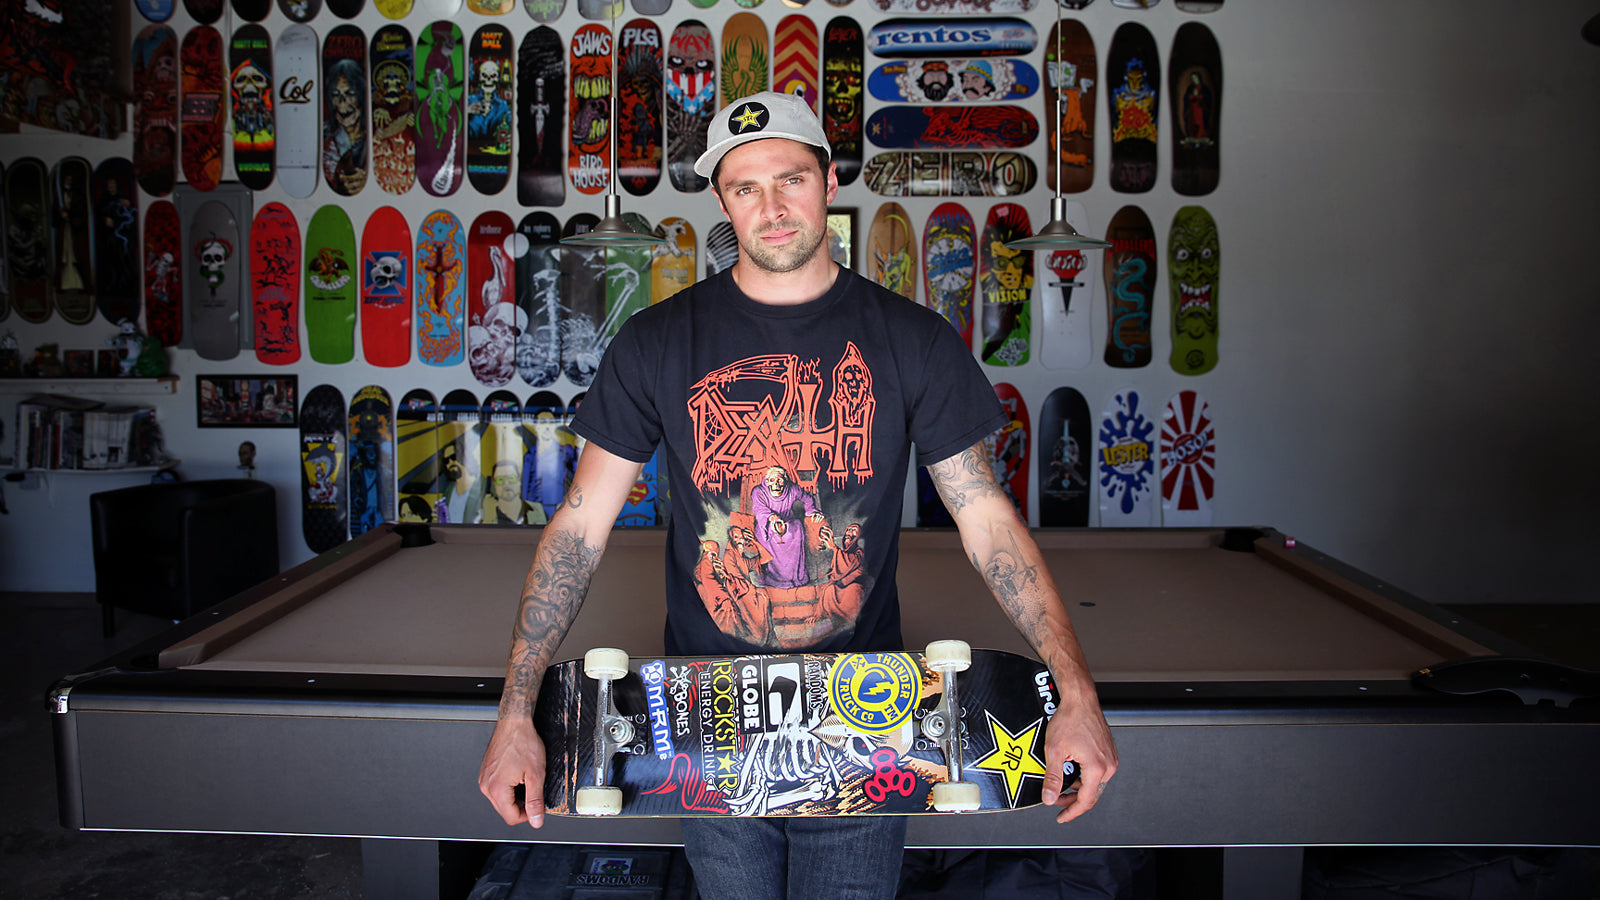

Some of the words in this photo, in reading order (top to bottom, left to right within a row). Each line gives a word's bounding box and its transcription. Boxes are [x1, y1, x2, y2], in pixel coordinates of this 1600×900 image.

[572, 29, 612, 57] JAWS
[622, 28, 660, 49] PLG
[669, 33, 711, 50] WAY
[877, 26, 992, 46] rentos
[572, 168, 608, 189] HOUSE
[578, 154, 603, 169] BIRD
[866, 152, 1027, 196] ZERO
[988, 289, 1027, 303] VISION
[687, 340, 876, 498] DEATH
[1103, 442, 1150, 466] LESTER
[808, 660, 824, 713] RANDOMS
[876, 653, 910, 700] THUNDER
[700, 672, 713, 728] ENERGY
[741, 664, 761, 731] GLOBE
[838, 677, 859, 717] TRUCK
[673, 691, 692, 738] BONES
[703, 734, 717, 785] DRINK
[575, 873, 651, 887] RANDOMS
